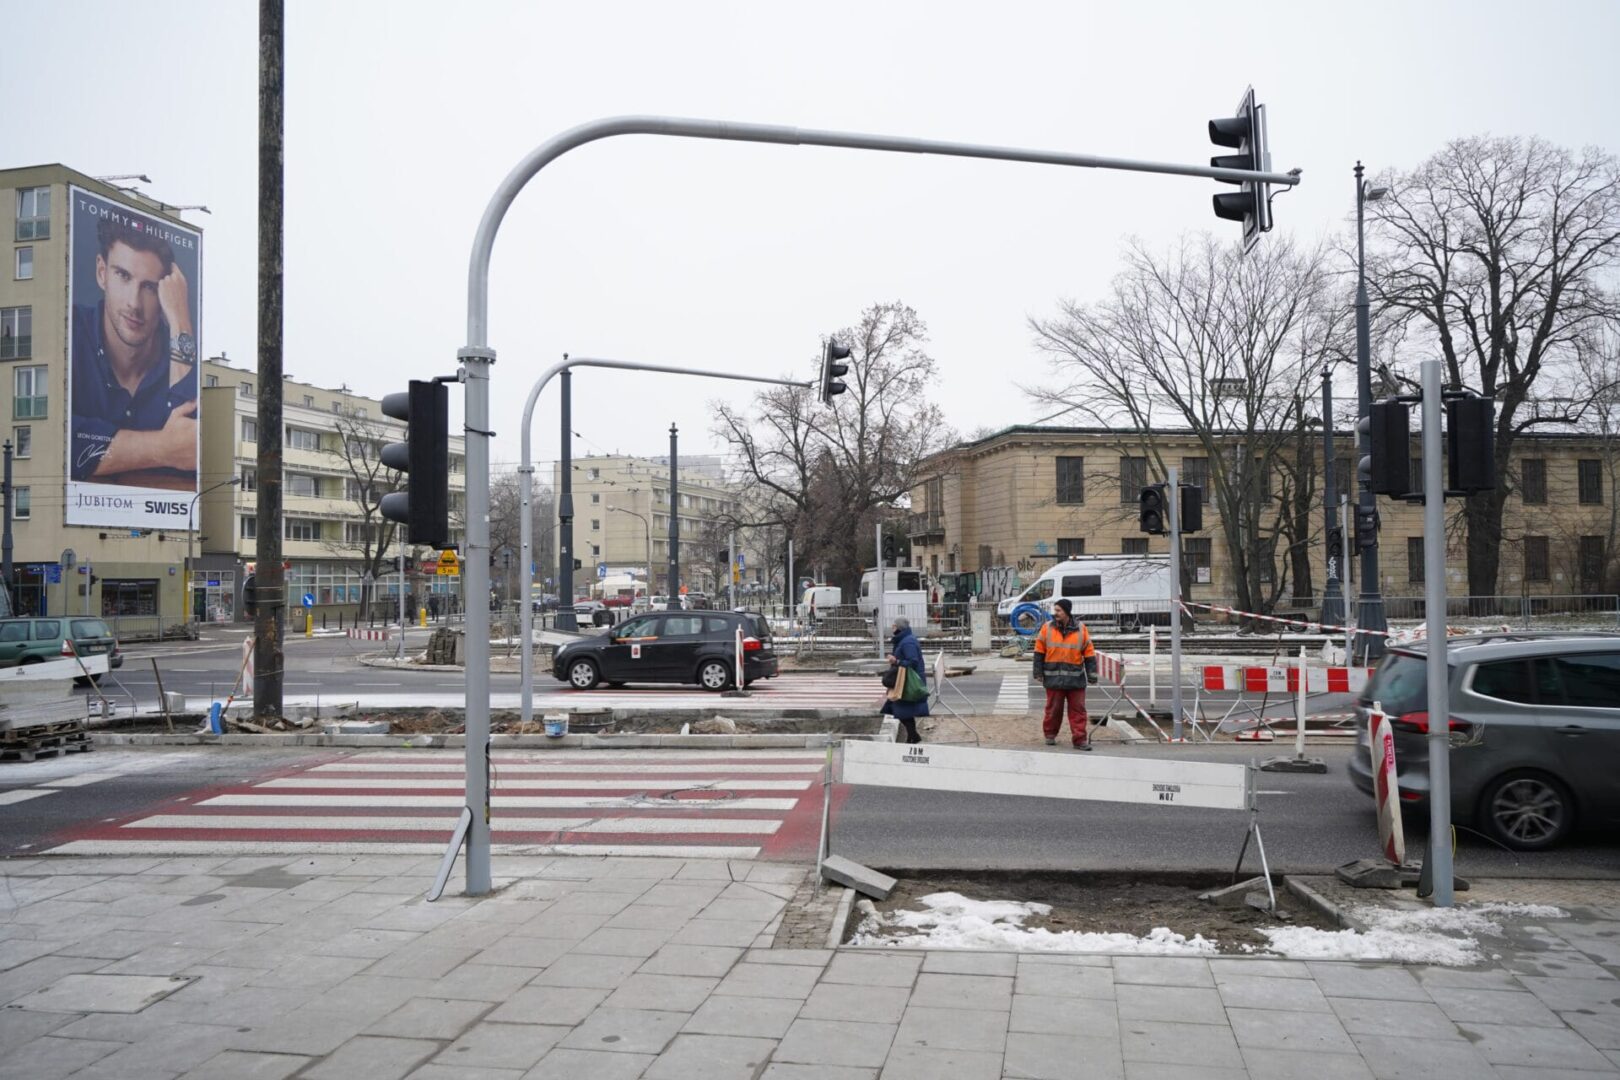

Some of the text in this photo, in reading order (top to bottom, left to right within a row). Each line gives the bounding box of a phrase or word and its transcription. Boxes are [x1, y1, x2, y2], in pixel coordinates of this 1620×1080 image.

[79, 200, 194, 249] TOMMY HILFIGER
[78, 493, 133, 508] JUBITOM
[145, 500, 188, 515] SWISS
